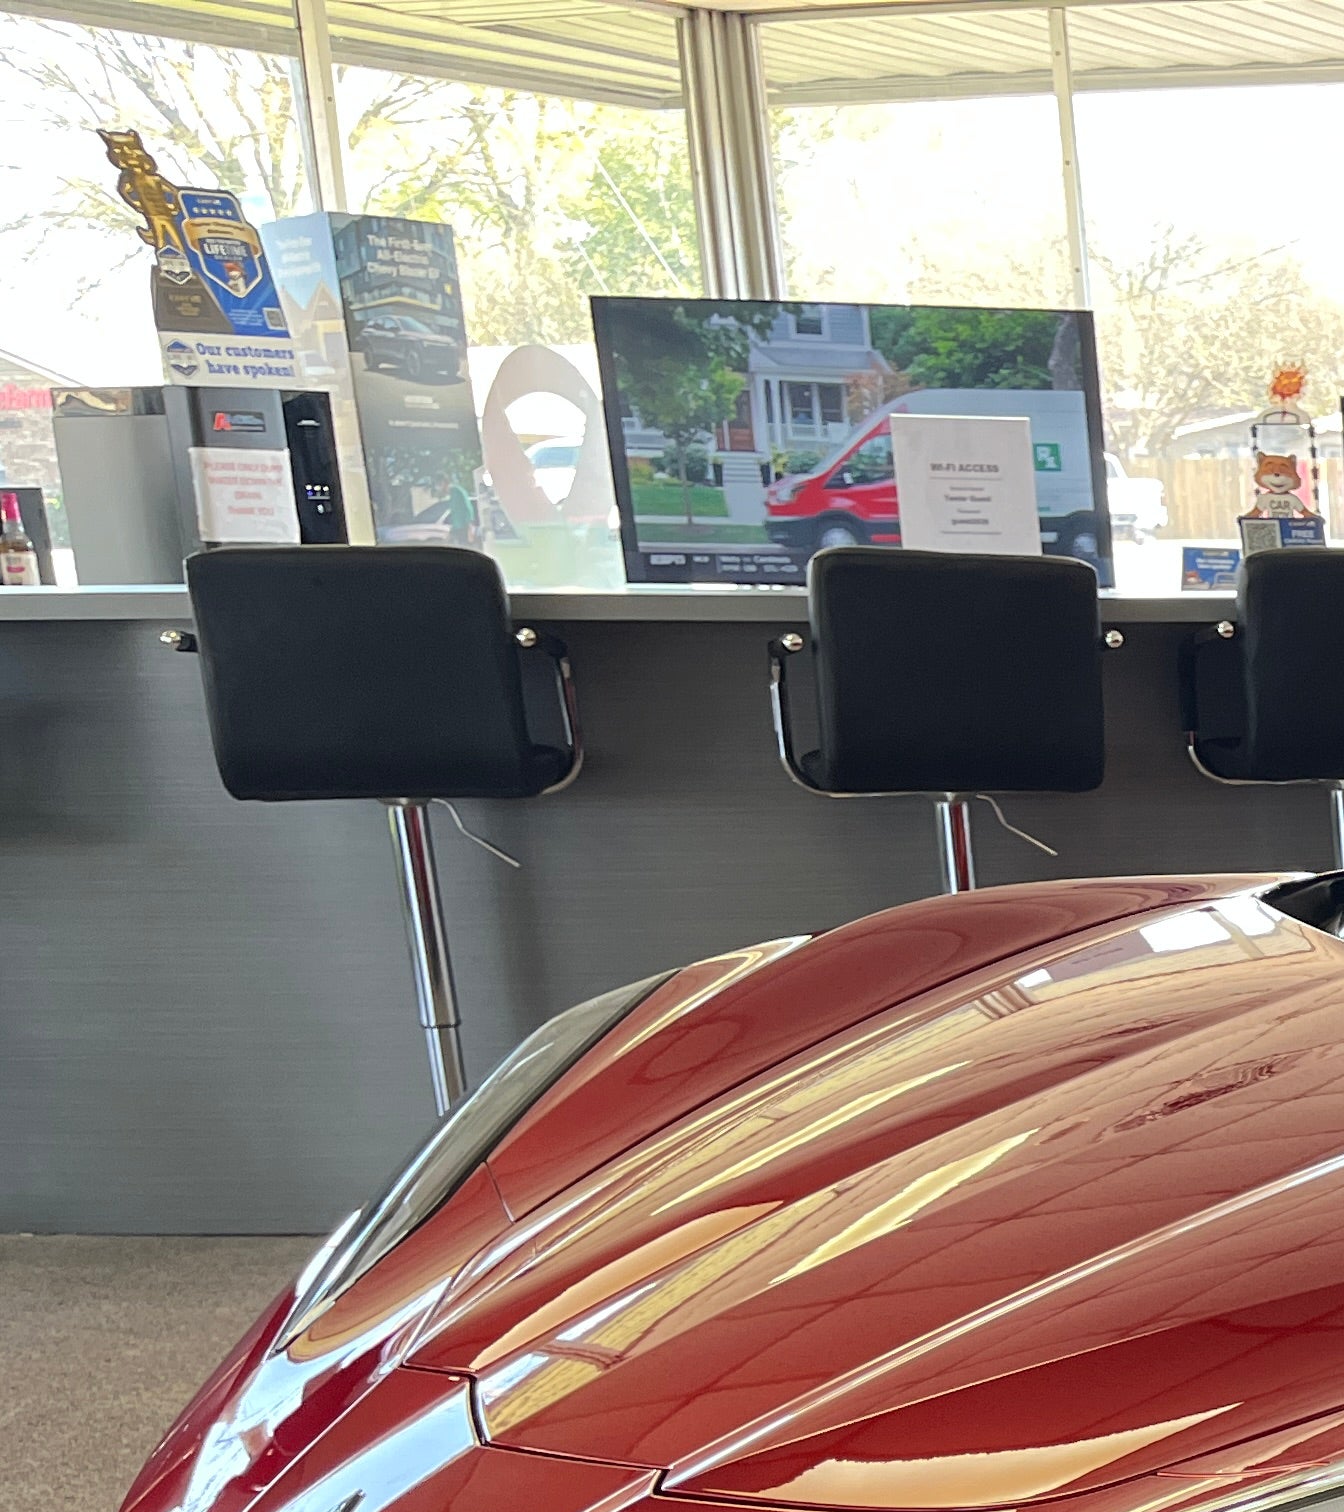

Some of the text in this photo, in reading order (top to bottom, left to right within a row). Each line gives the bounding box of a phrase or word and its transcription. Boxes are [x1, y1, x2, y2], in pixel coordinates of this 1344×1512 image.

[367, 262, 397, 277] Chevy
[196, 342, 295, 360] Our customers
[206, 360, 240, 374] have
[958, 464, 1000, 473] ACCESS
[1269, 500, 1290, 510] CAR
